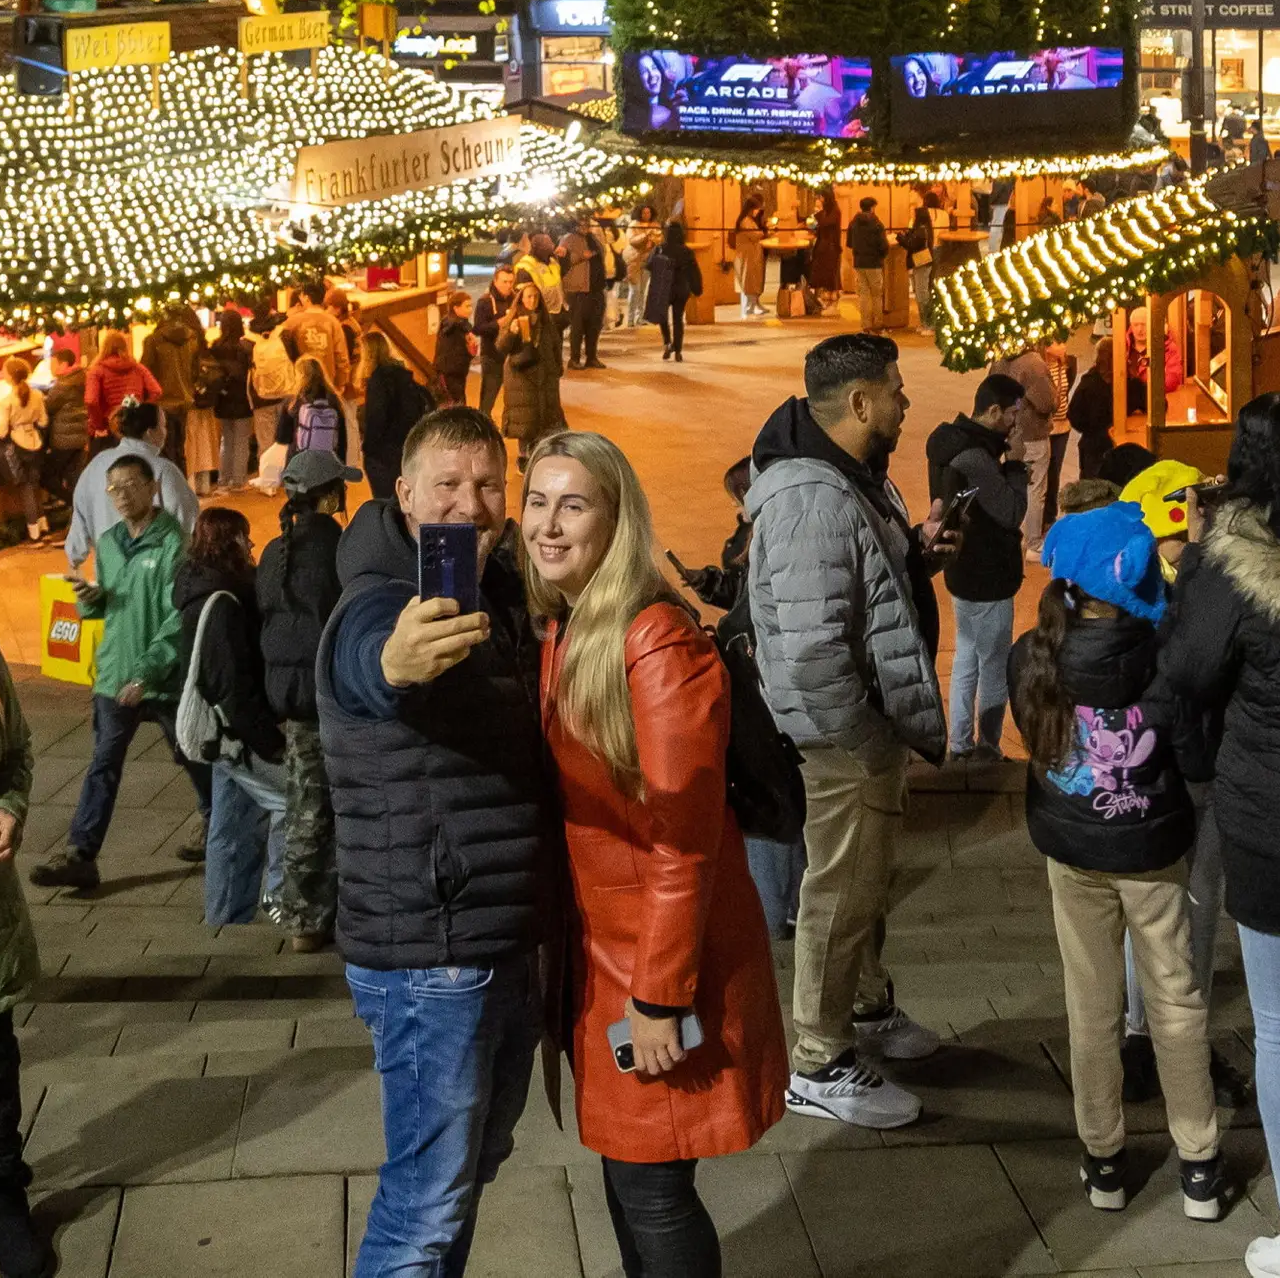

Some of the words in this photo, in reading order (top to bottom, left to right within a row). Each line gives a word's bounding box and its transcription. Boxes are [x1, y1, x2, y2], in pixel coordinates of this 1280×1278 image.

[1160, 4, 1215, 16] STRT
[1219, 4, 1274, 16] COFFEE
[245, 21, 294, 47] German
[299, 17, 325, 40] Beer
[704, 85, 788, 99] ARCADE
[678, 106, 710, 115] RACE.
[711, 107, 745, 116] DRINK.
[747, 108, 770, 117] EAT.
[771, 109, 814, 118] REPEAT.
[304, 149, 431, 202] Frankfurter
[440, 136, 515, 176] Scheune
[50, 619, 79, 643] LEGO
